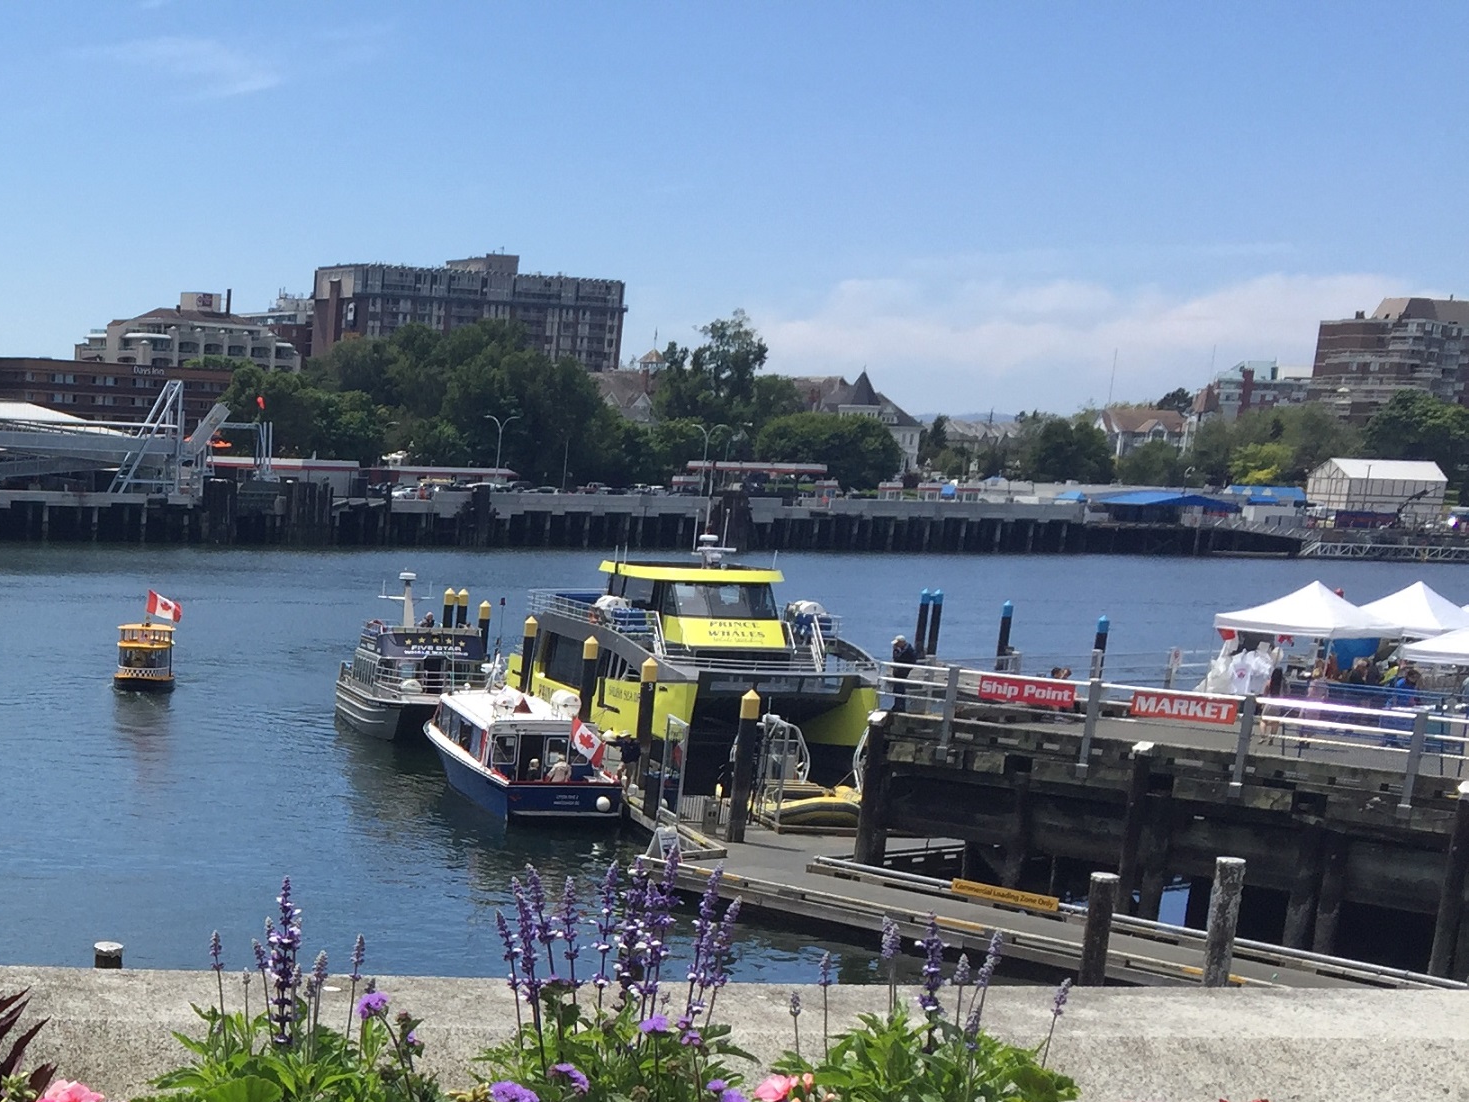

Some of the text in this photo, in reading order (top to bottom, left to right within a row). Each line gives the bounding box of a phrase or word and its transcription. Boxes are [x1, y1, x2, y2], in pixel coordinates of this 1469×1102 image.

[708, 620, 761, 629] PRINCE
[708, 629, 766, 639] WHALES
[648, 682, 654, 692] 3
[981, 680, 1072, 702] Ship Point
[1135, 696, 1234, 720] MARKET
[955, 883, 1055, 908] Commercial Loading Zone Only
